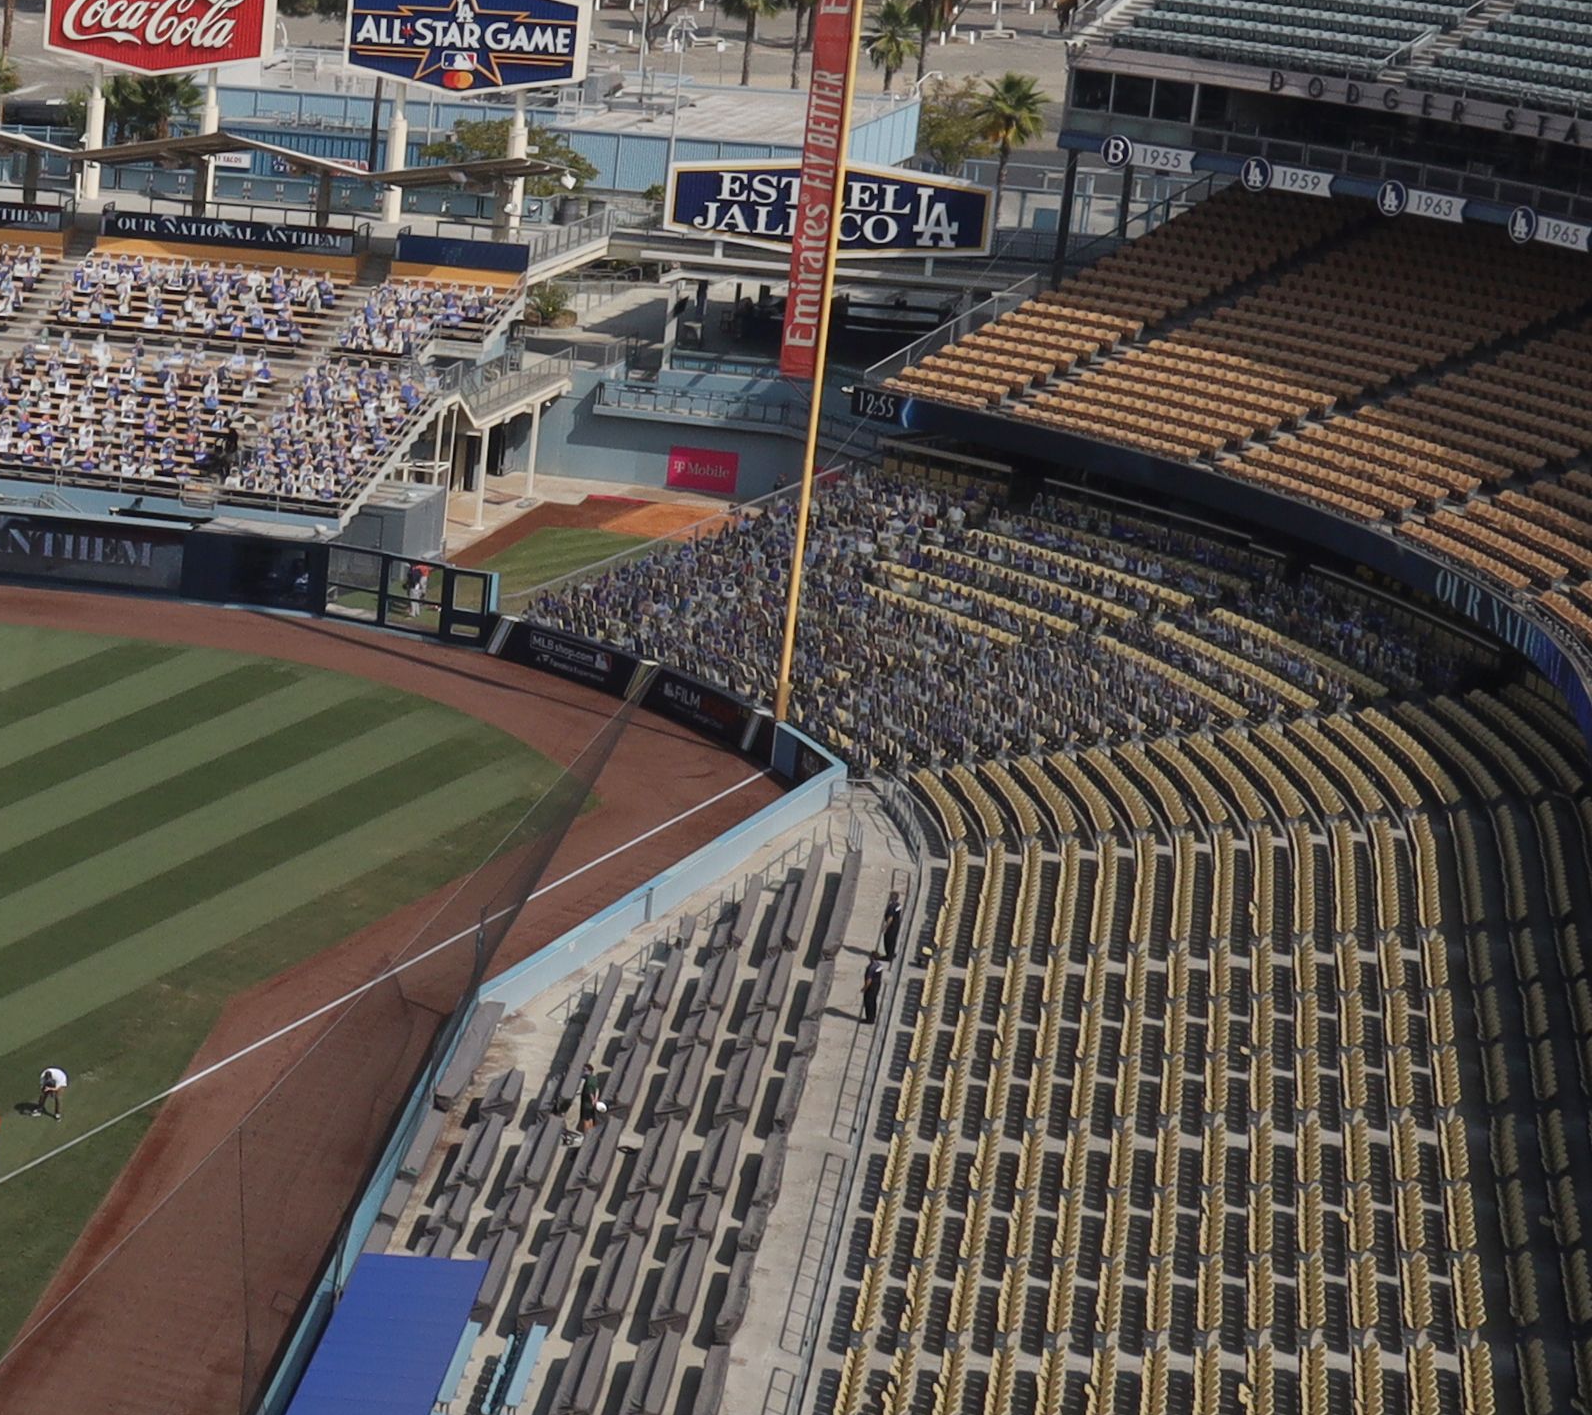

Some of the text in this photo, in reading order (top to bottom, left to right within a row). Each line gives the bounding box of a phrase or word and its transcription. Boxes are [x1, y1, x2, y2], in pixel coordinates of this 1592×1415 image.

[484, 24, 571, 54] GAME
[1270, 70, 1464, 123] DODGER
[808, 69, 844, 149] BETTER
[1141, 148, 1181, 167] 1955
[801, 156, 835, 190] FLY
[1281, 170, 1321, 192] 1959
[1416, 194, 1453, 216] 1963
[117, 217, 341, 249] OUR NATIONAL ANTHEM
[1544, 223, 1580, 245] 1965
[859, 394, 894, 417] 12:55
[688, 460, 730, 478] Mobile
